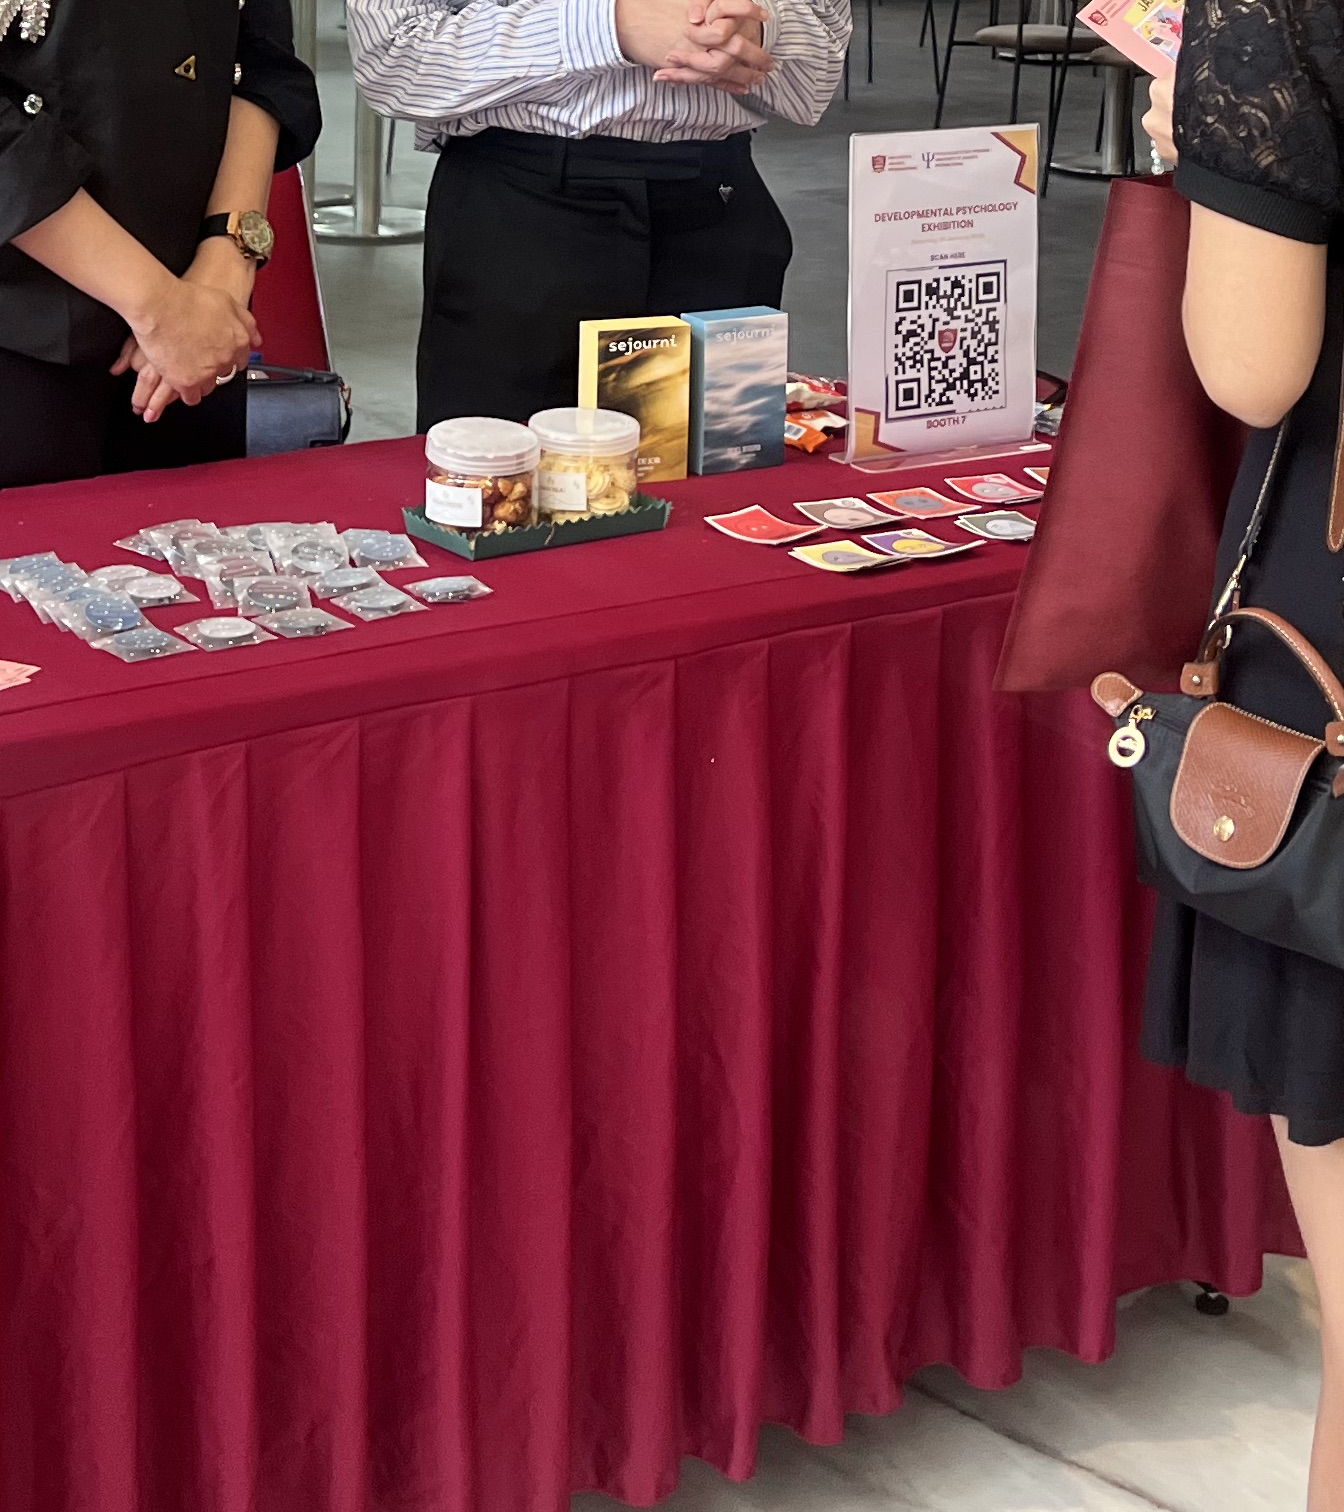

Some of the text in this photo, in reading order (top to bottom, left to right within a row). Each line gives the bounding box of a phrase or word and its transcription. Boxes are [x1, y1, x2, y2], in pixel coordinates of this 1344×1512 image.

[874, 201, 1019, 223] DEVELOPMENTAL PSYCHOLOGY
[921, 219, 974, 233] EXHIBITION
[608, 334, 678, 356] sejourni
[715, 323, 777, 345] sejourni
[926, 416, 959, 429] BOOTH
